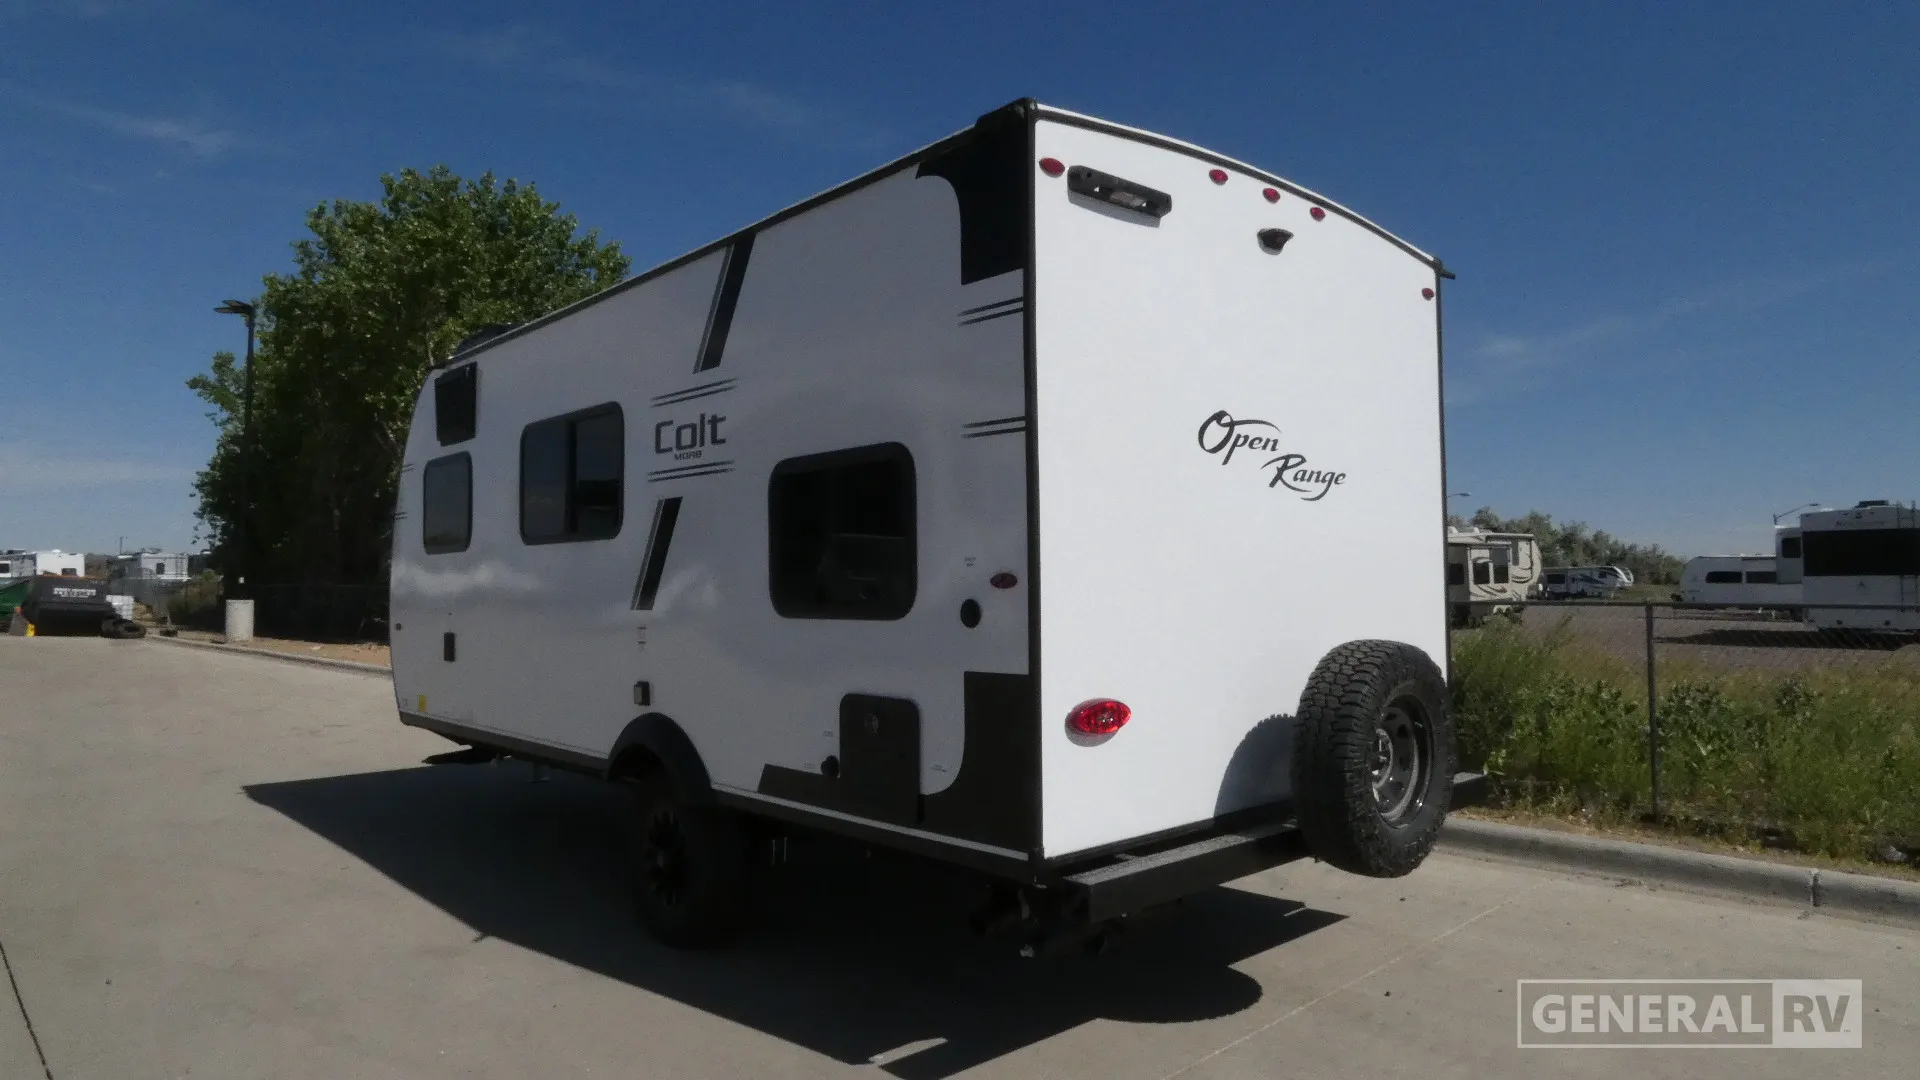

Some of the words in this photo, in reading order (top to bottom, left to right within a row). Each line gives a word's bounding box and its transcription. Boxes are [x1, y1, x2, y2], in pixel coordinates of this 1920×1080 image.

[655, 413, 726, 454] Colt
[1198, 410, 1282, 466] Open
[1260, 453, 1346, 502] Range
